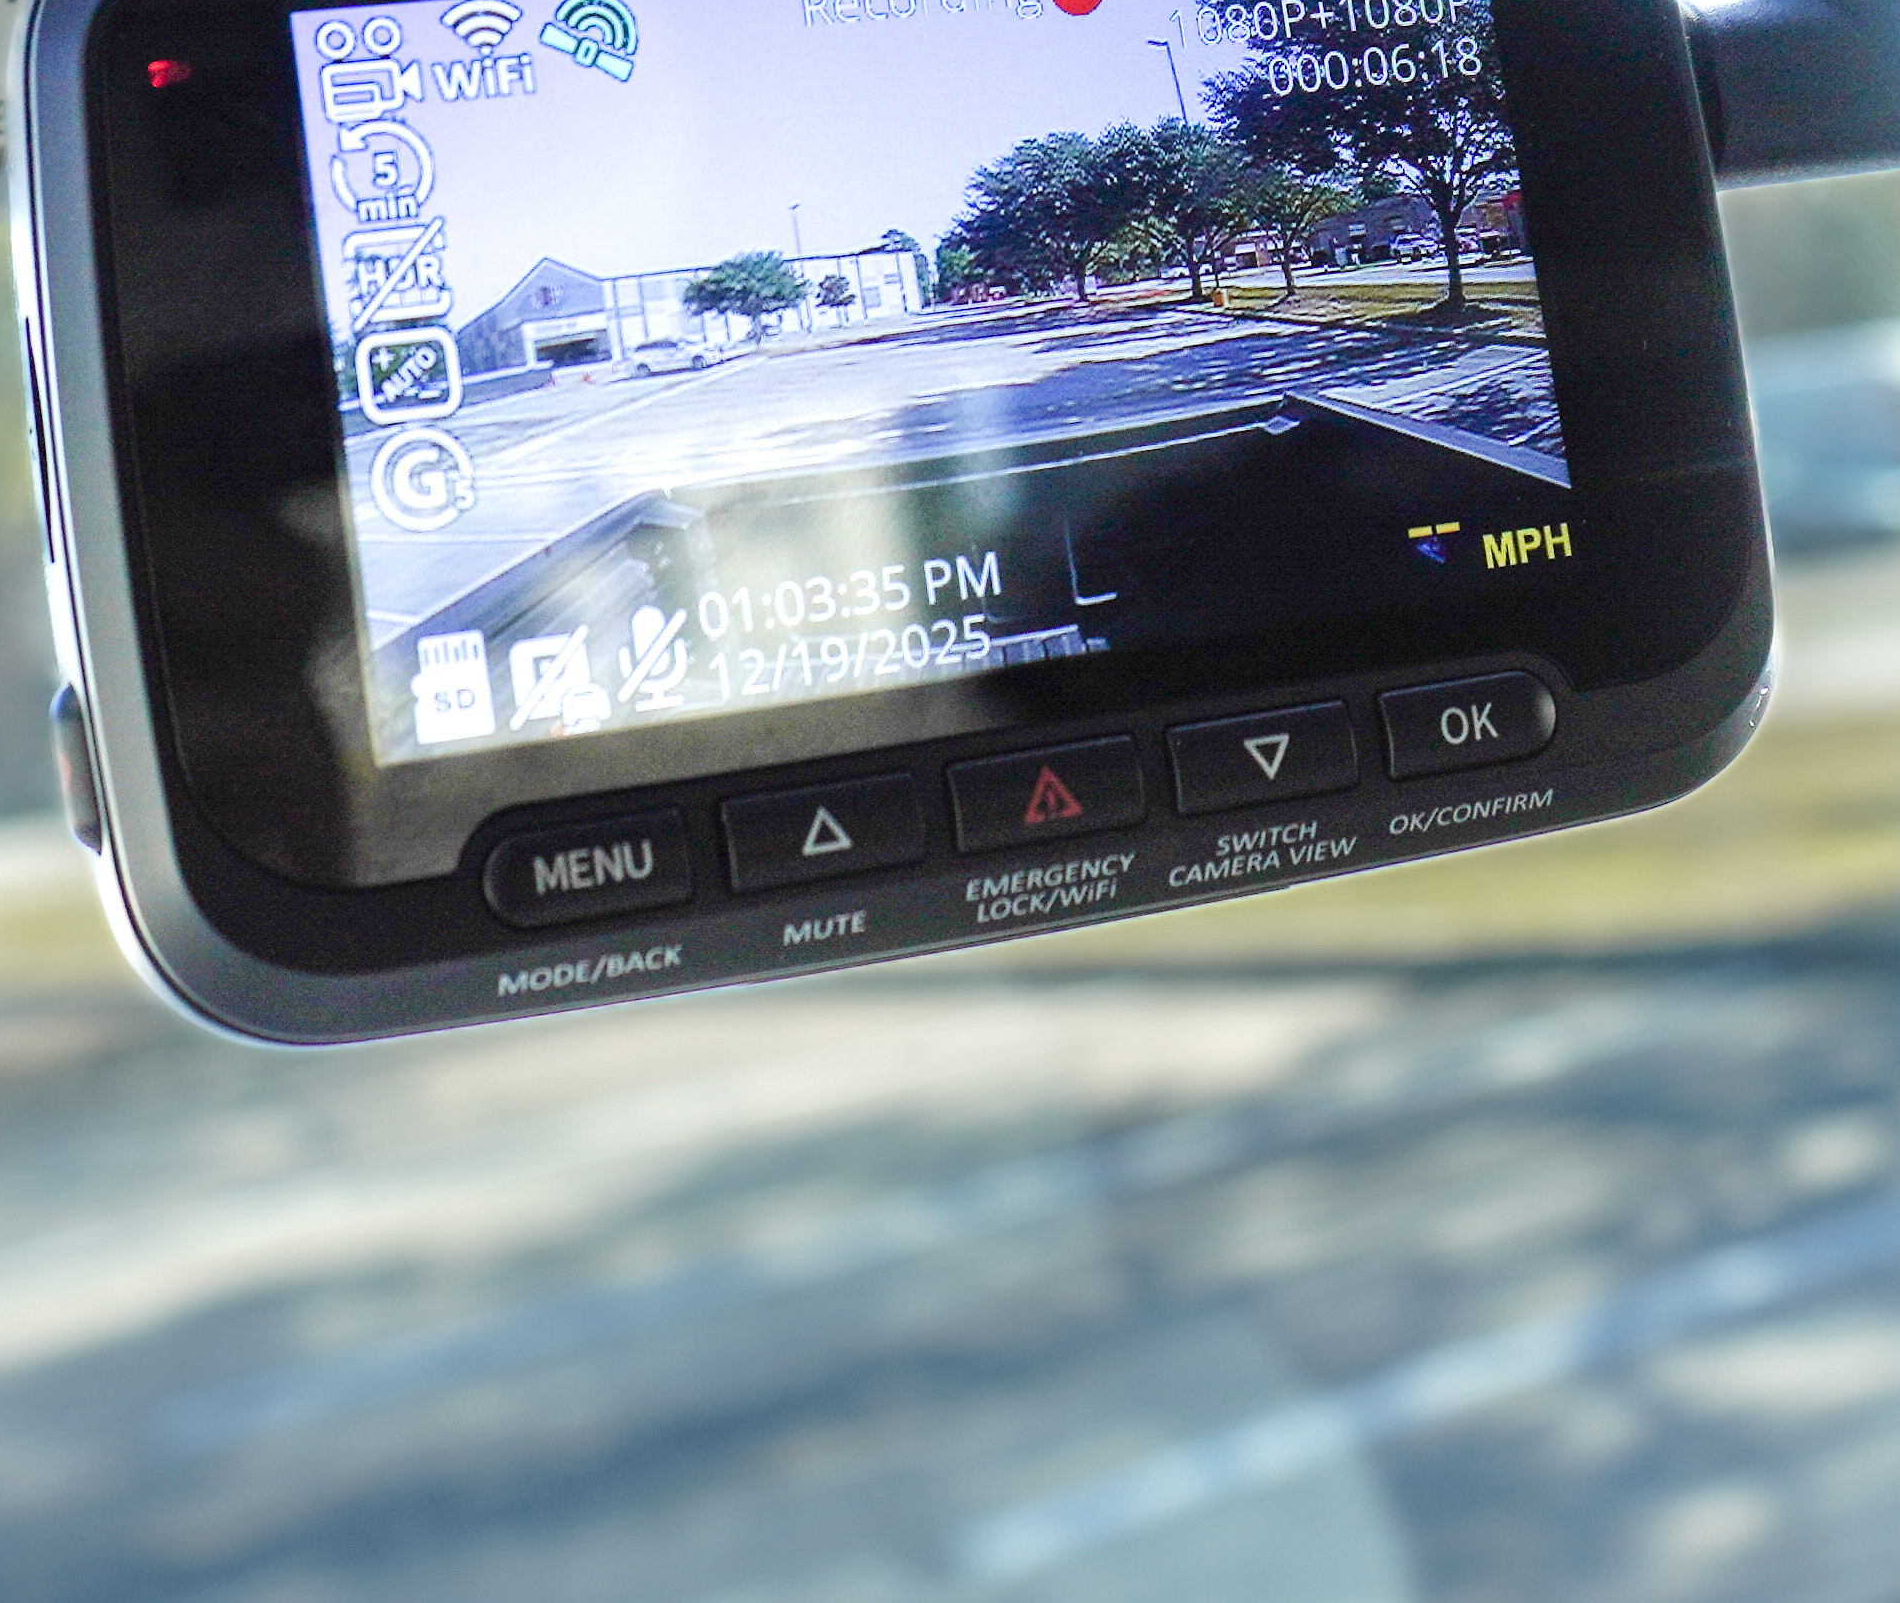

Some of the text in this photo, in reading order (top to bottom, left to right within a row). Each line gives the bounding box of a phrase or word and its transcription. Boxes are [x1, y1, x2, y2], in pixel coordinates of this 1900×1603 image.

[431, 52, 537, 102] WiFi
[1269, 36, 1483, 96] 000:06:18
[1482, 522, 1572, 569] MPH
[699, 551, 1002, 639] 01:03:35 PM
[710, 613, 993, 699] 12/19/2025
[433, 687, 477, 714] SD
[1439, 702, 1499, 745] OK
[1387, 787, 1554, 837] OK/CONFIRM
[1167, 836, 1358, 888] CAMERA VIEW
[1215, 820, 1318, 857] SWITCH
[532, 838, 654, 896] MENU
[965, 853, 1136, 902] EMERGENCY
[976, 881, 1118, 924] LOCK/WiFi
[782, 910, 868, 948] MUTE
[497, 943, 684, 998] MODE/BACK
